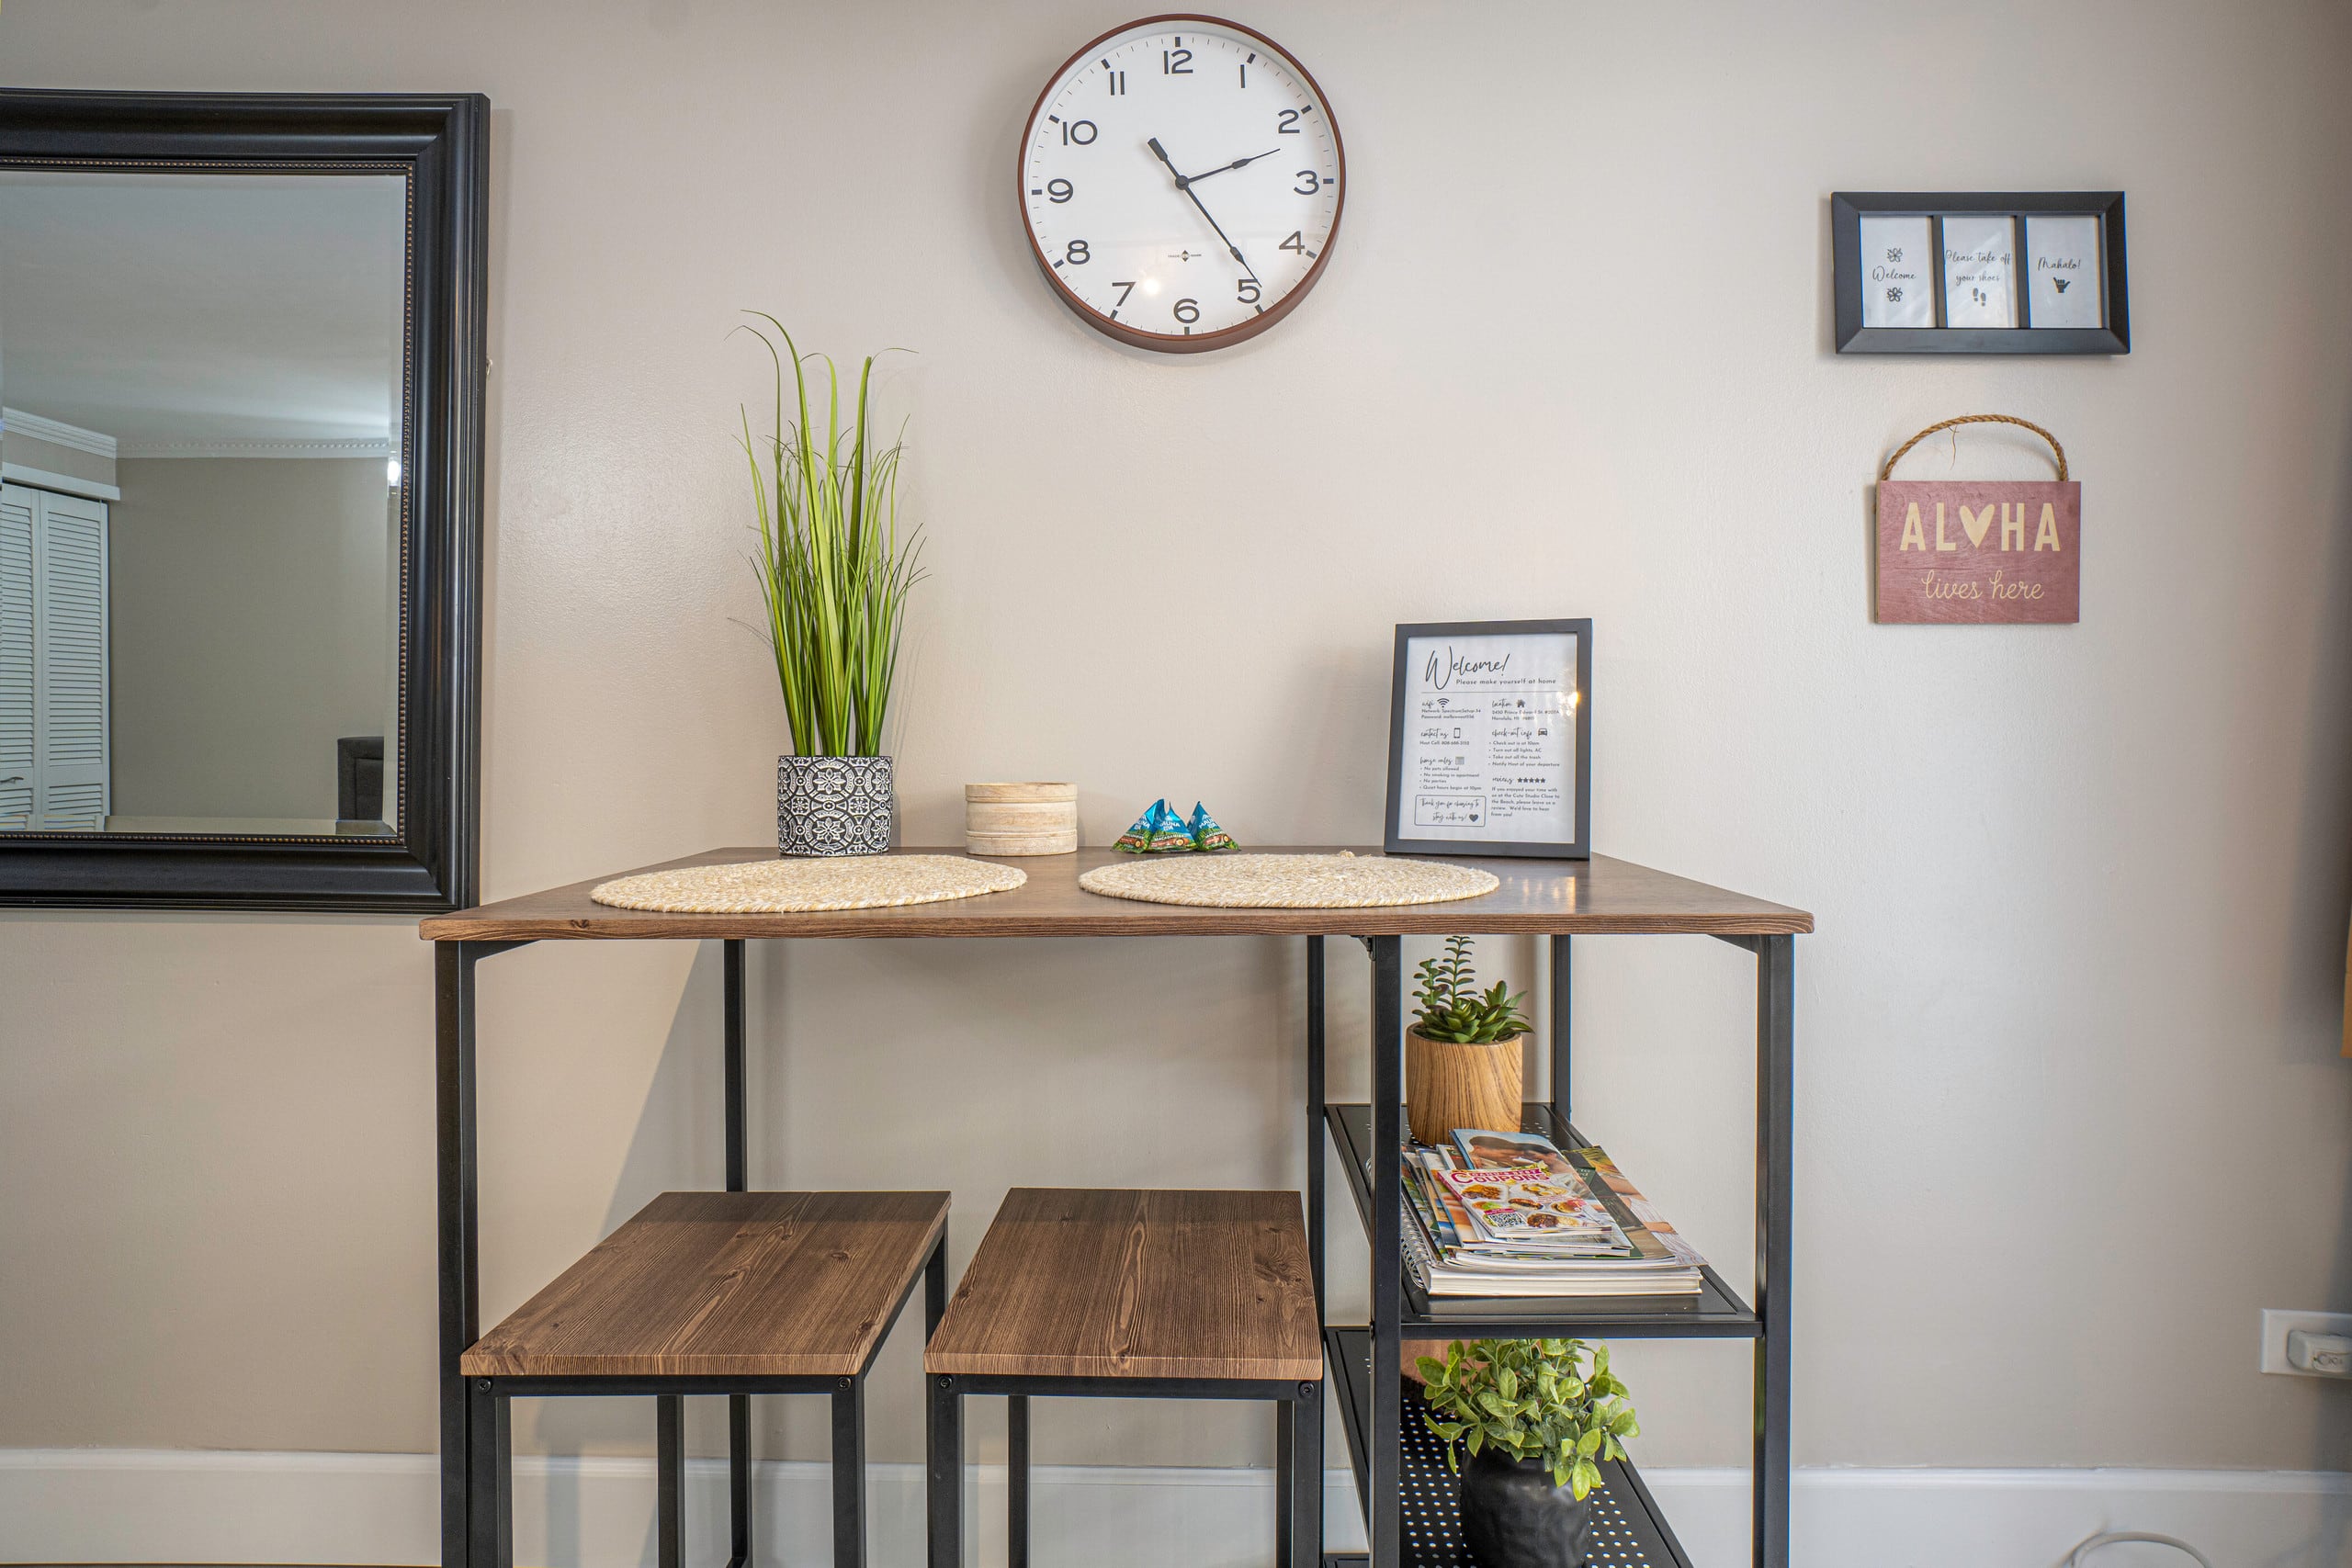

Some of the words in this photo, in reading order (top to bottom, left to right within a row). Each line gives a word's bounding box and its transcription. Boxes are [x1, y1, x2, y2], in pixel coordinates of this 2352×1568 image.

[1163, 49, 1193, 74] 12
[1110, 71, 1125, 96] 11
[1240, 64, 1246, 88] 1
[1062, 120, 1098, 145] 10
[1278, 109, 1300, 134] 2
[1047, 178, 1074, 204] 9
[1294, 170, 1319, 195] 3
[1066, 239, 1091, 265] 8
[1278, 231, 1306, 255] 4
[1943, 249, 1974, 265] Please
[1976, 251, 1997, 264] take
[2000, 252, 2012, 265] off
[2037, 256, 2081, 271] Mahalo!
[1871, 265, 1917, 282] Welcome
[1955, 273, 1977, 286] your
[1979, 270, 2000, 283] shoes
[1112, 281, 1136, 307] 7
[1237, 278, 1261, 304] 5
[1173, 298, 1200, 324] 6
[1921, 569, 1984, 599] lives
[1988, 570, 2045, 600] here
[1425, 646, 1510, 690] Welcome!
[1499, 678, 1526, 686] yourself
[1451, 1172, 1550, 1184] COUPONS
